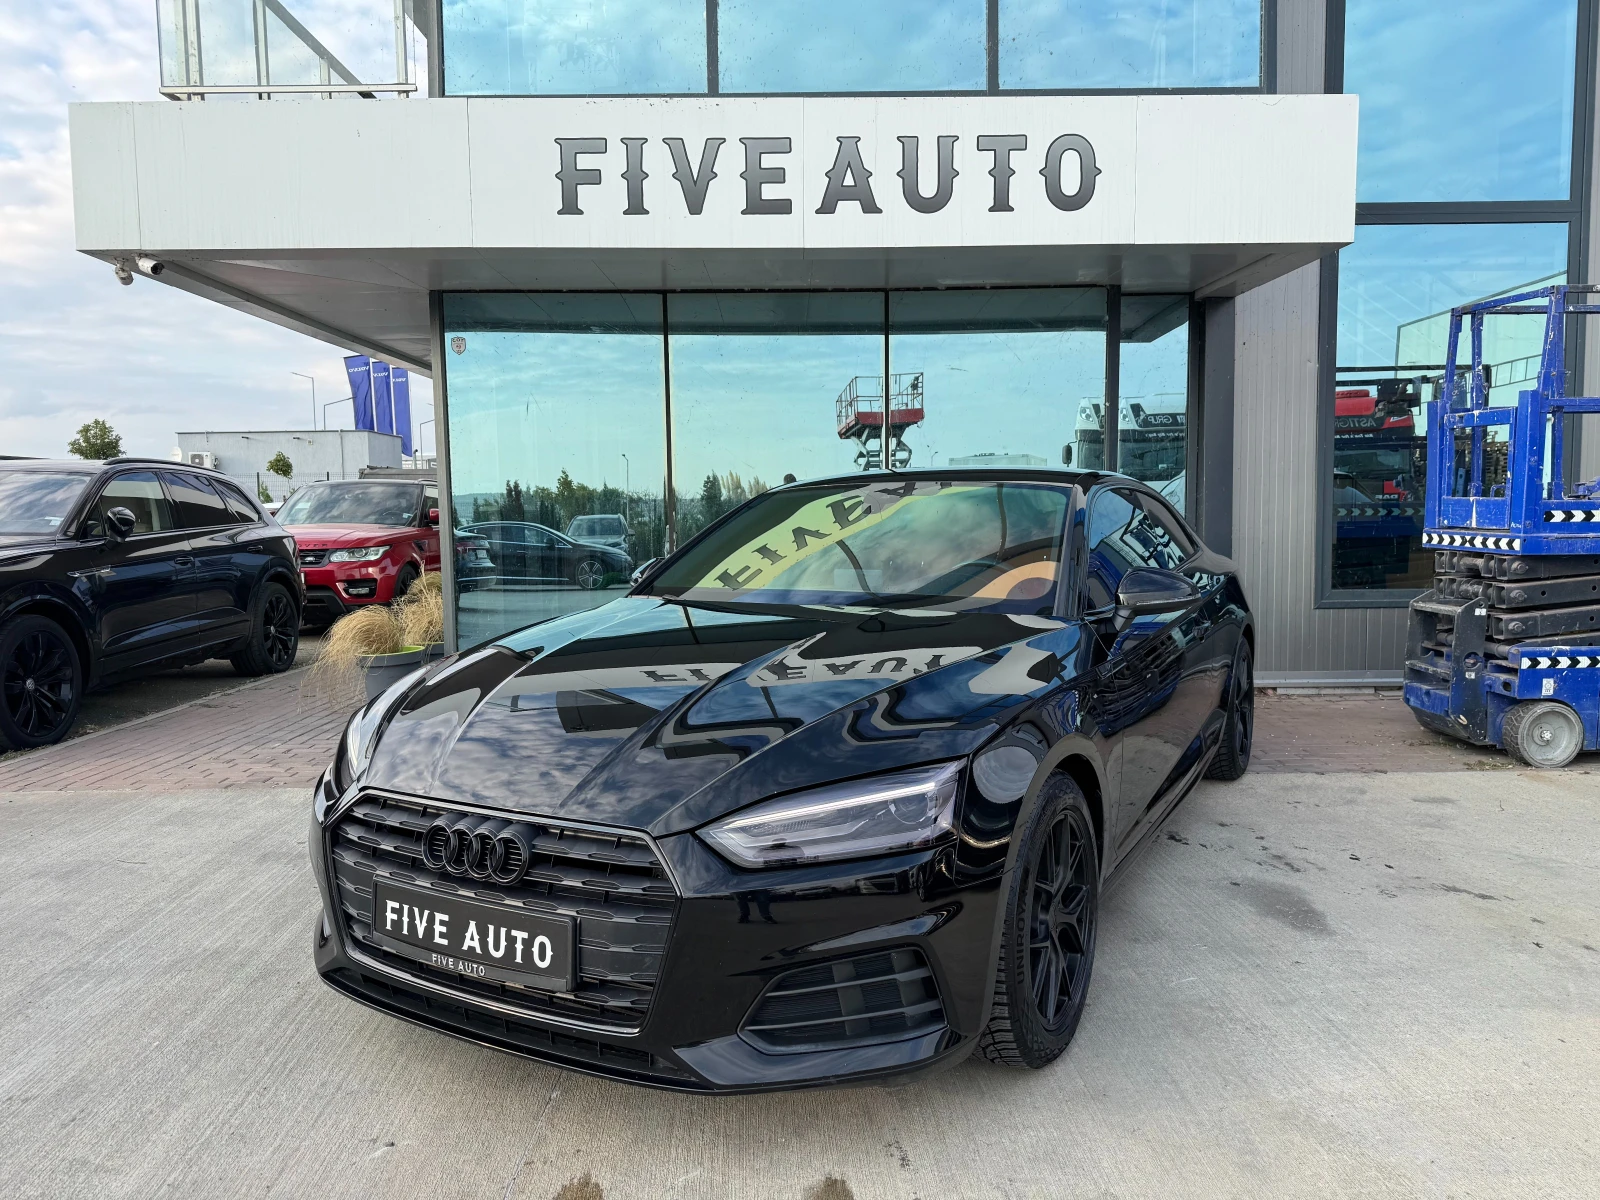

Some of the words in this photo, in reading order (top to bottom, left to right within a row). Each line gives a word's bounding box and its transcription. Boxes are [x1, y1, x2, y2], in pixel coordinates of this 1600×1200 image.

[385, 899, 450, 946] FIVE
[461, 919, 554, 969] AUTO
[431, 953, 454, 969] FIVE
[458, 960, 486, 976] AUTO
